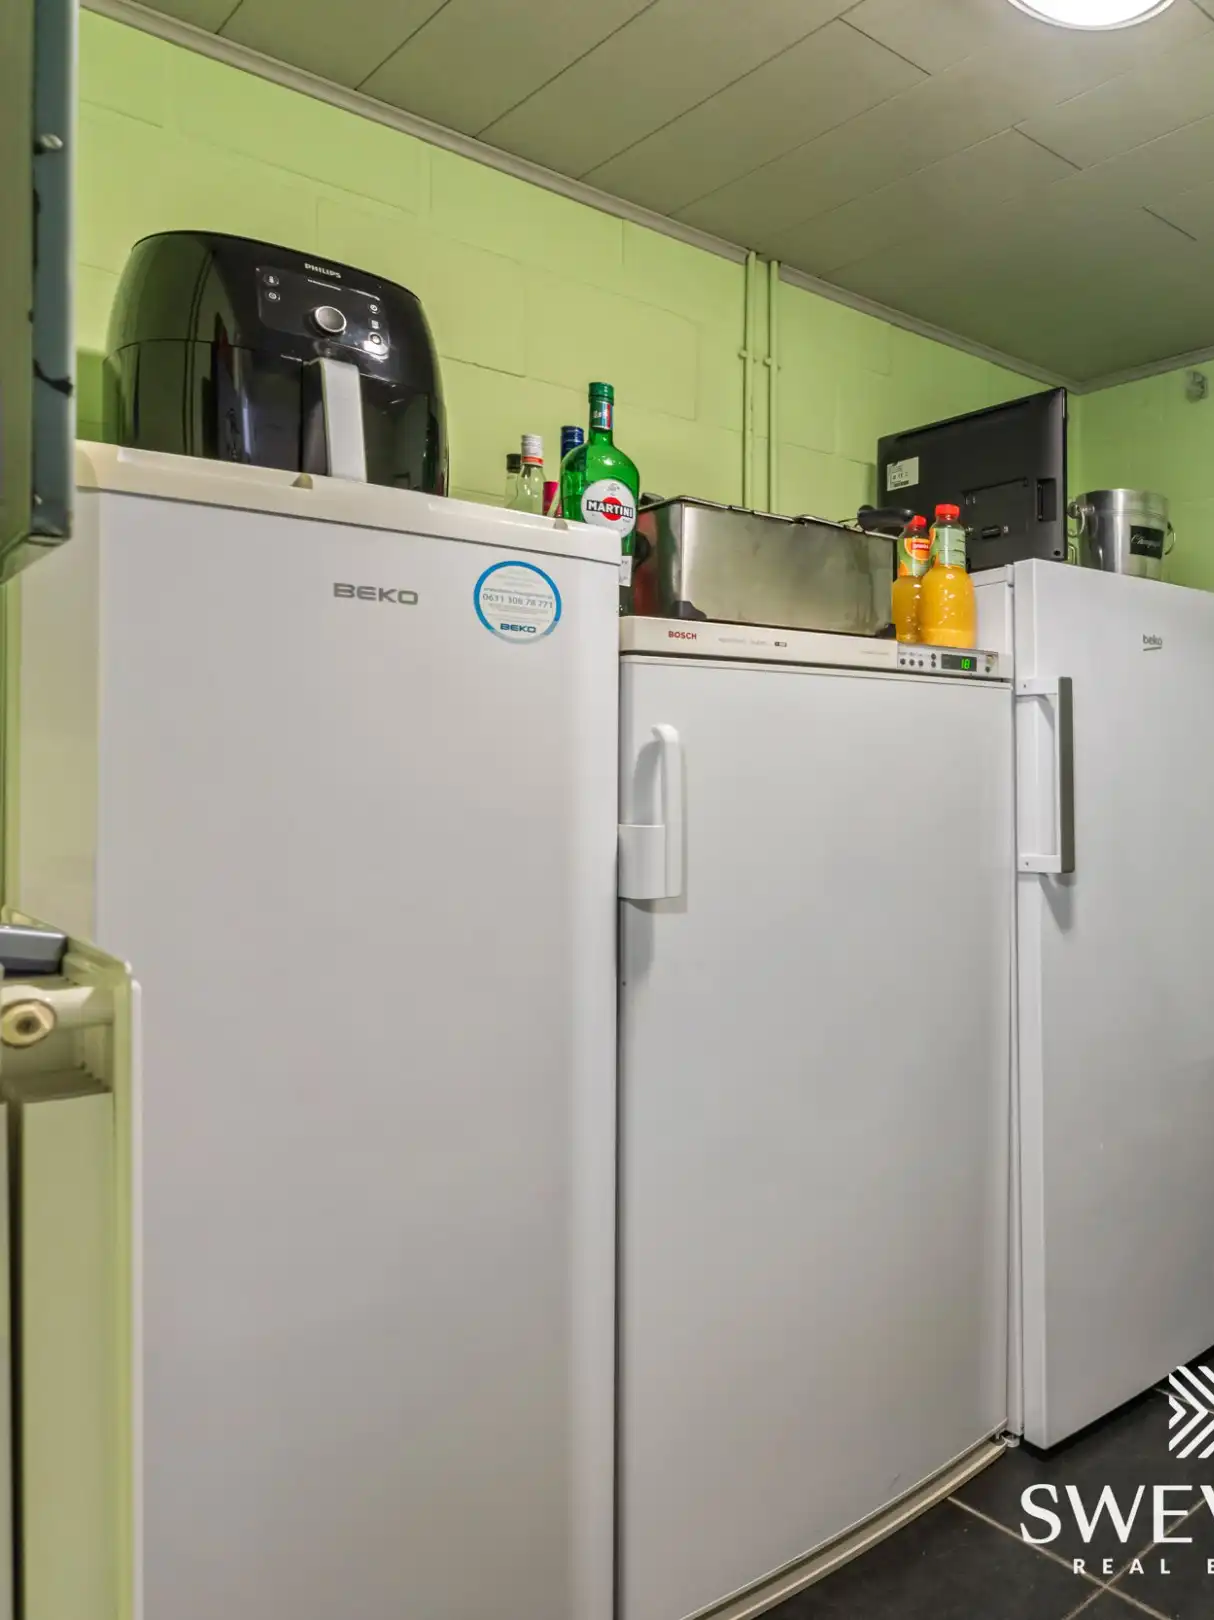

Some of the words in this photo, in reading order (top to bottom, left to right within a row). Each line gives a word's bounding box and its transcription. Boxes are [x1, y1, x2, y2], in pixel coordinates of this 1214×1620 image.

[304, 262, 342, 279] PHILIPS
[586, 500, 634, 519] MARTINI
[333, 582, 419, 606] BEKO
[499, 622, 537, 634] BEKO
[668, 630, 698, 640] BOSCH
[1142, 633, 1163, 646] beko
